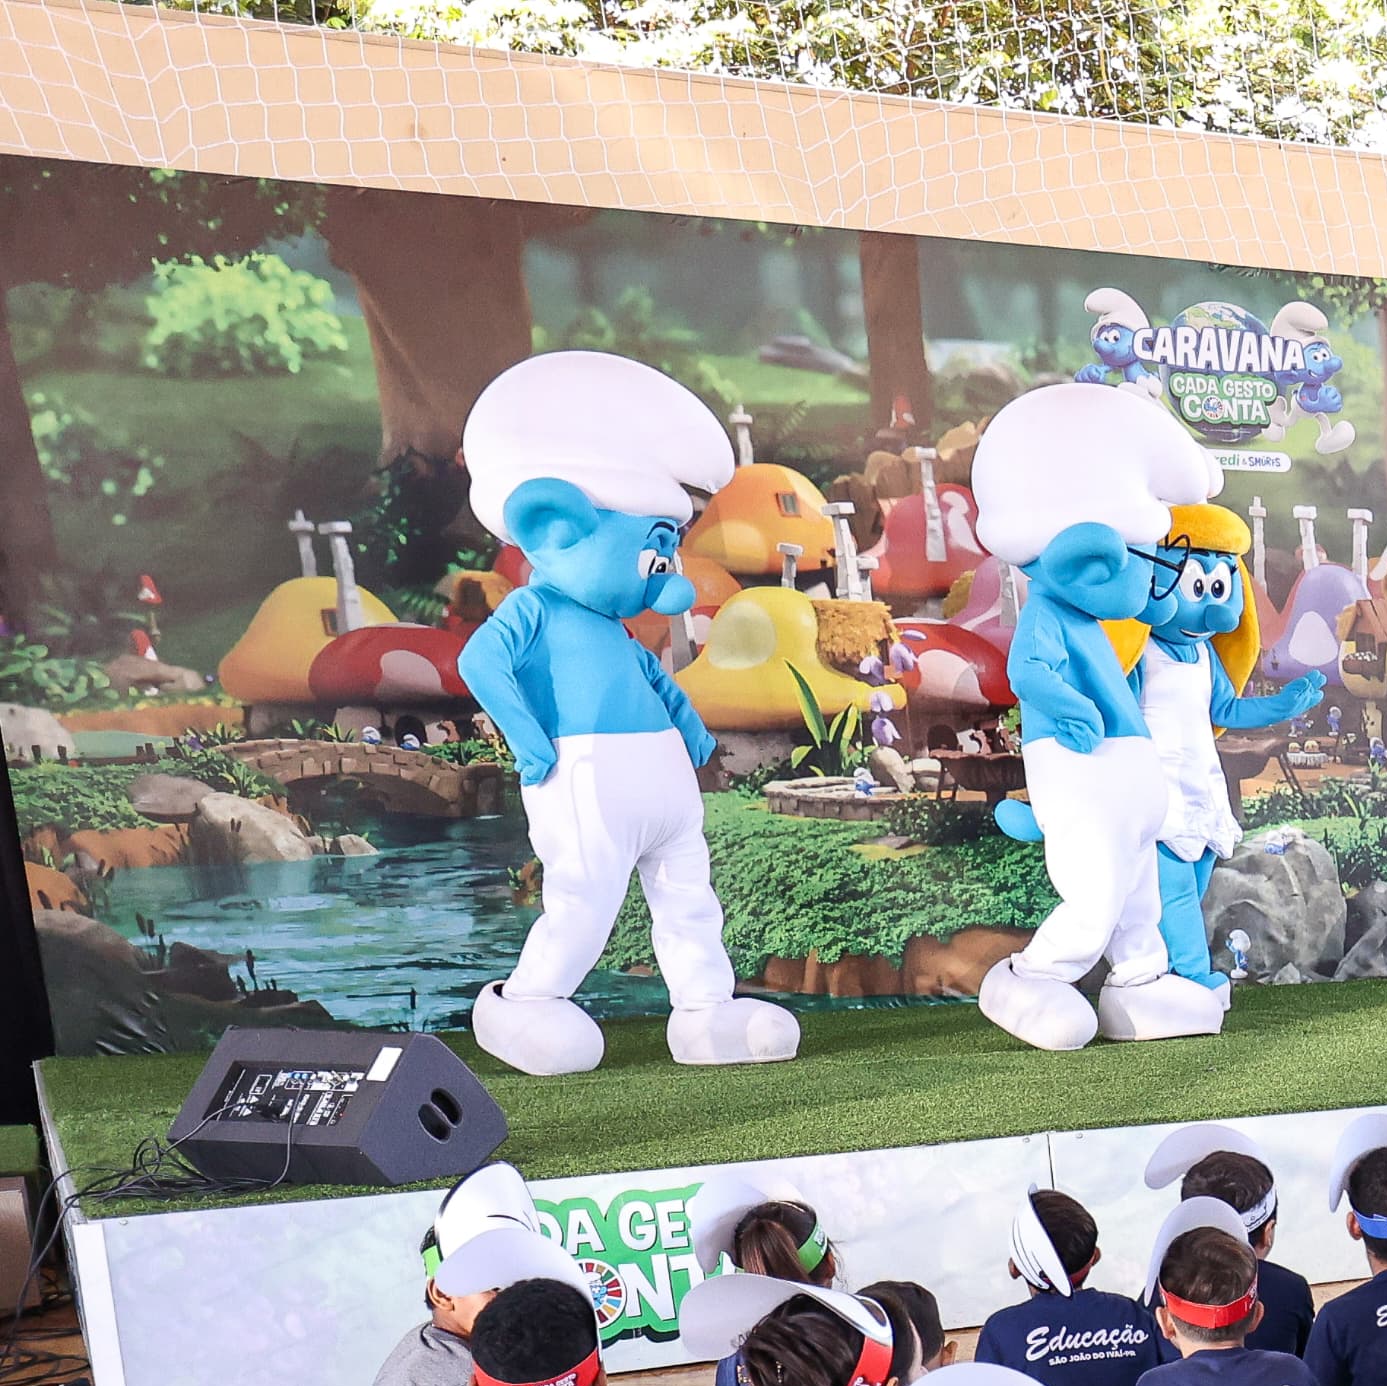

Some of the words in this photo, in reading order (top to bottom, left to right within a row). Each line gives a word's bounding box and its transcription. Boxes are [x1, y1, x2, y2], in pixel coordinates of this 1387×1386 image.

[1132, 326, 1306, 373] CARAVANA
[1172, 376, 1218, 396] CADA
[1223, 379, 1274, 399] GESTO
[1184, 395, 1267, 422] CONTA
[1213, 453, 1240, 467] redi
[1025, 1324, 1149, 1361] Educação
[1048, 1355, 1067, 1366] SÃO
[1069, 1352, 1092, 1363] JOÃO
[1092, 1352, 1105, 1360] DO
